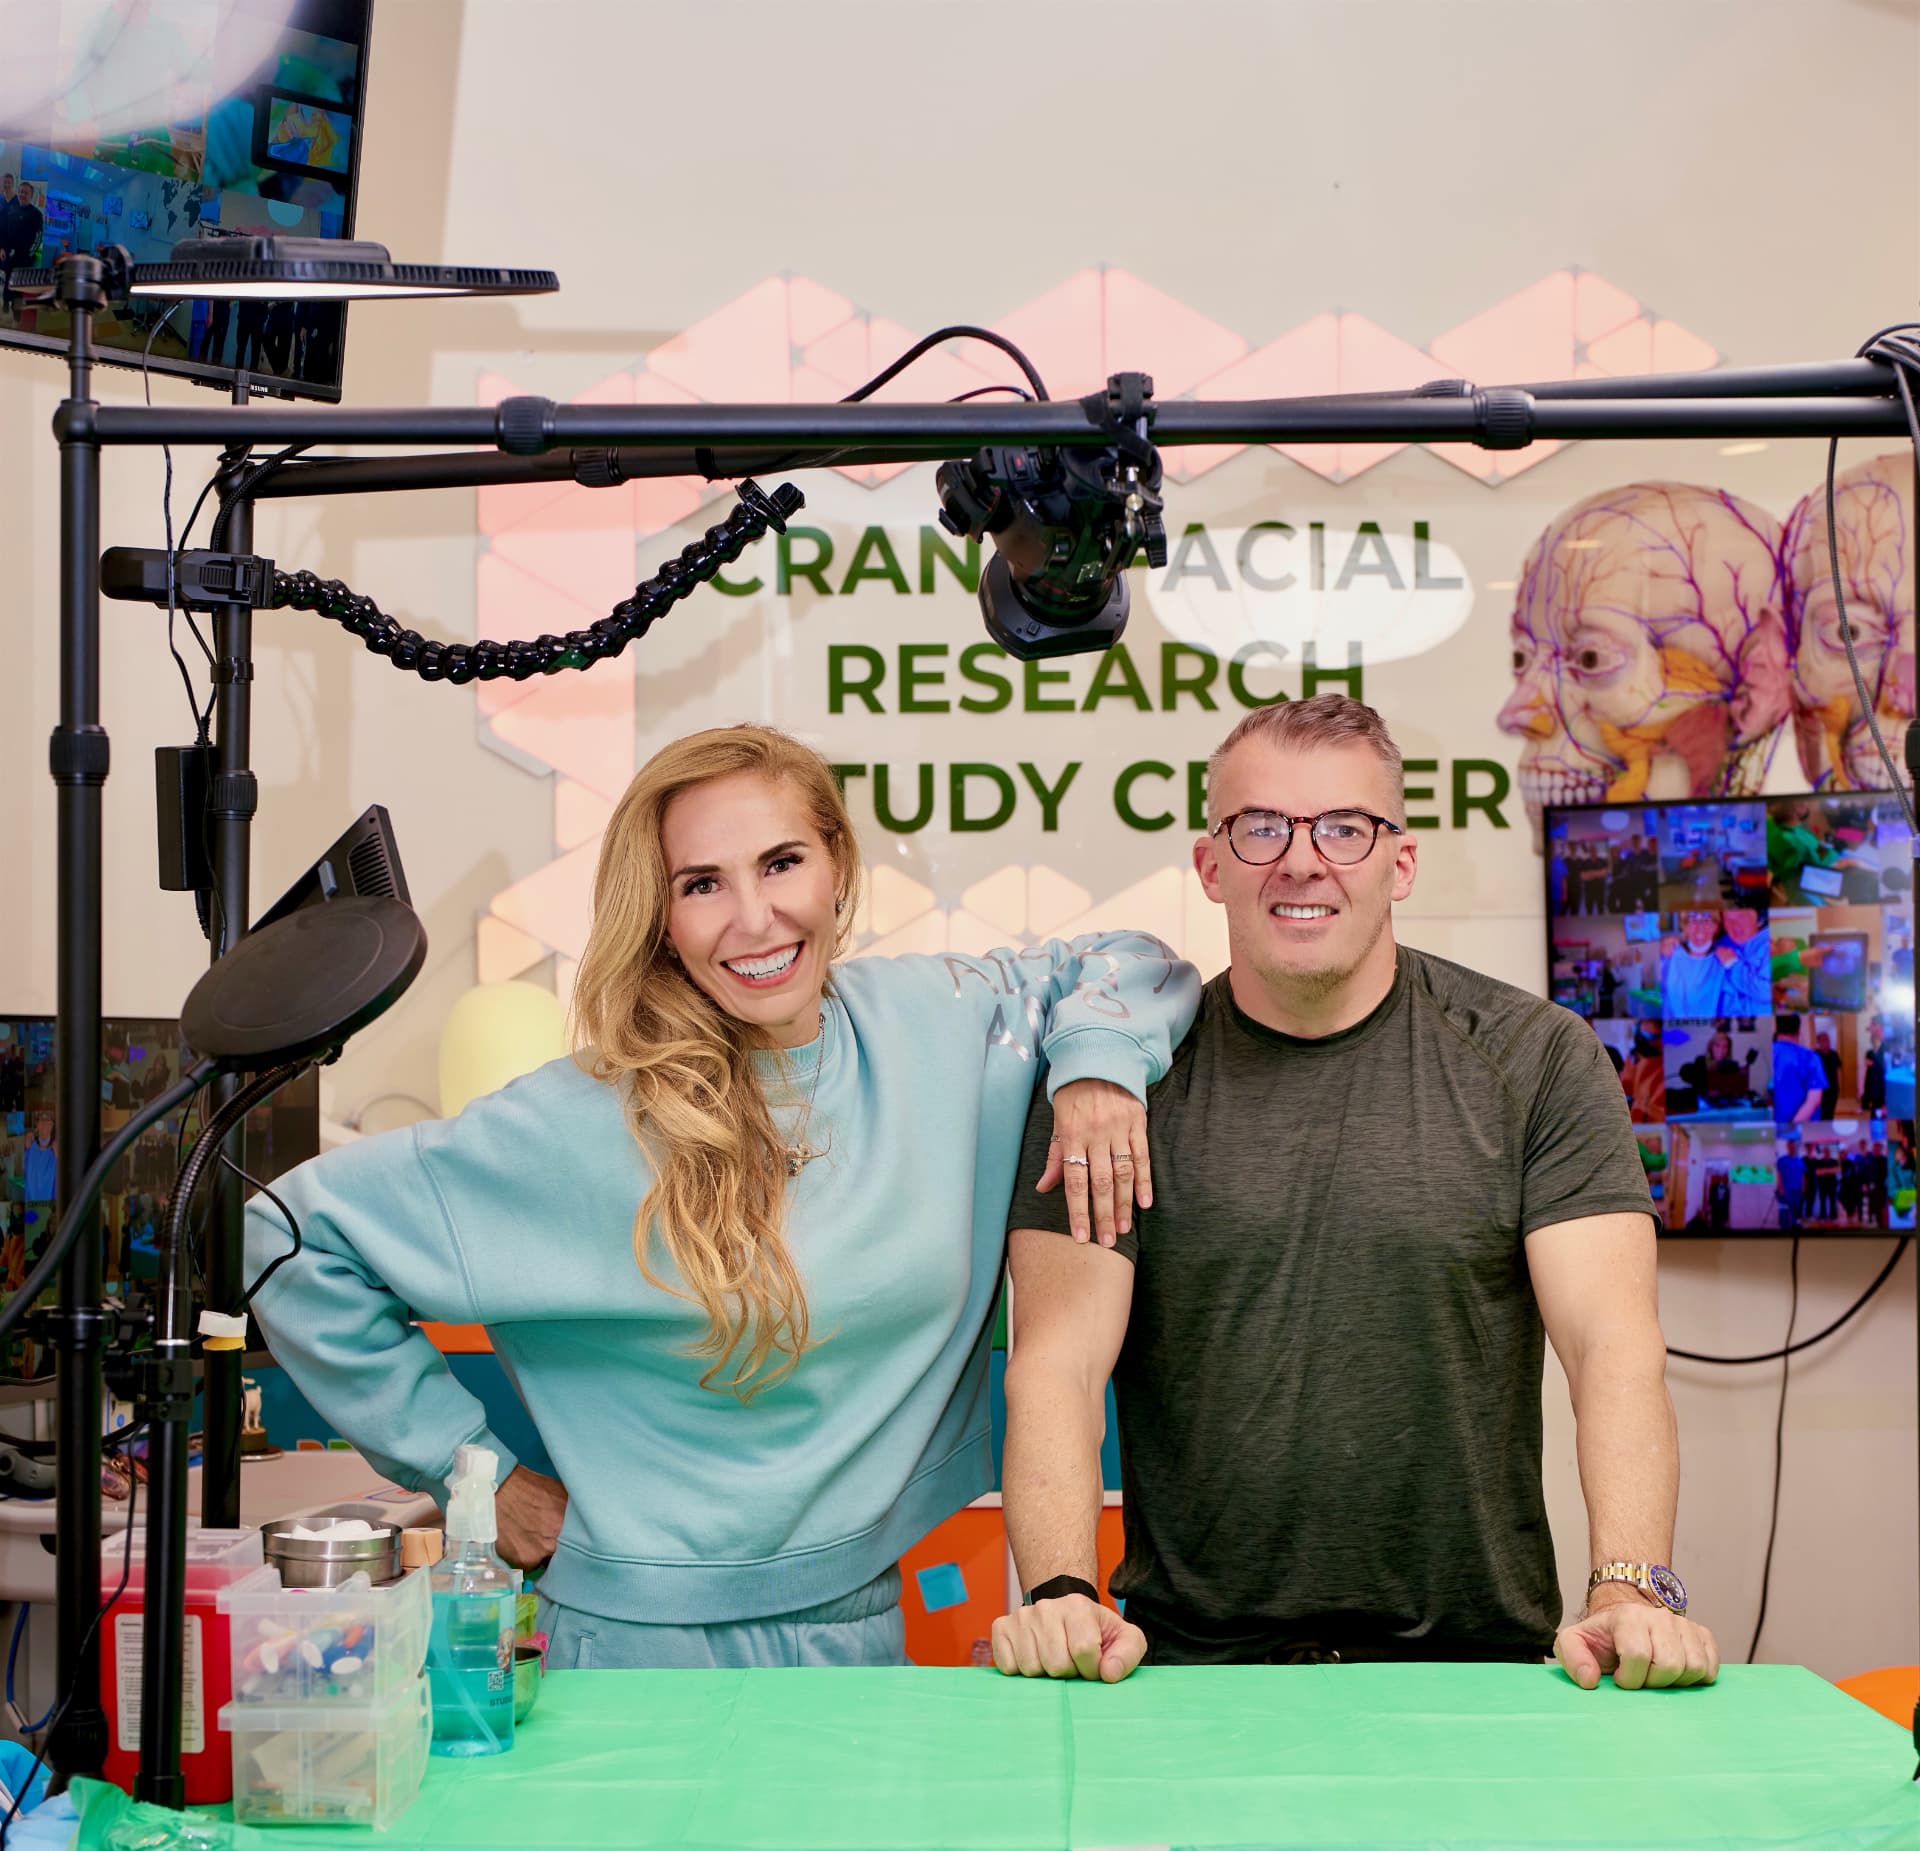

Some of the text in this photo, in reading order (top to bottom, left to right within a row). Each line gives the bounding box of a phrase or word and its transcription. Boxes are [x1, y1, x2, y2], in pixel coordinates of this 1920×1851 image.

[708, 521, 1464, 597] RANACIAL
[827, 640, 1363, 715] RESEARCH
[827, 758, 1511, 834] UDY CEER
